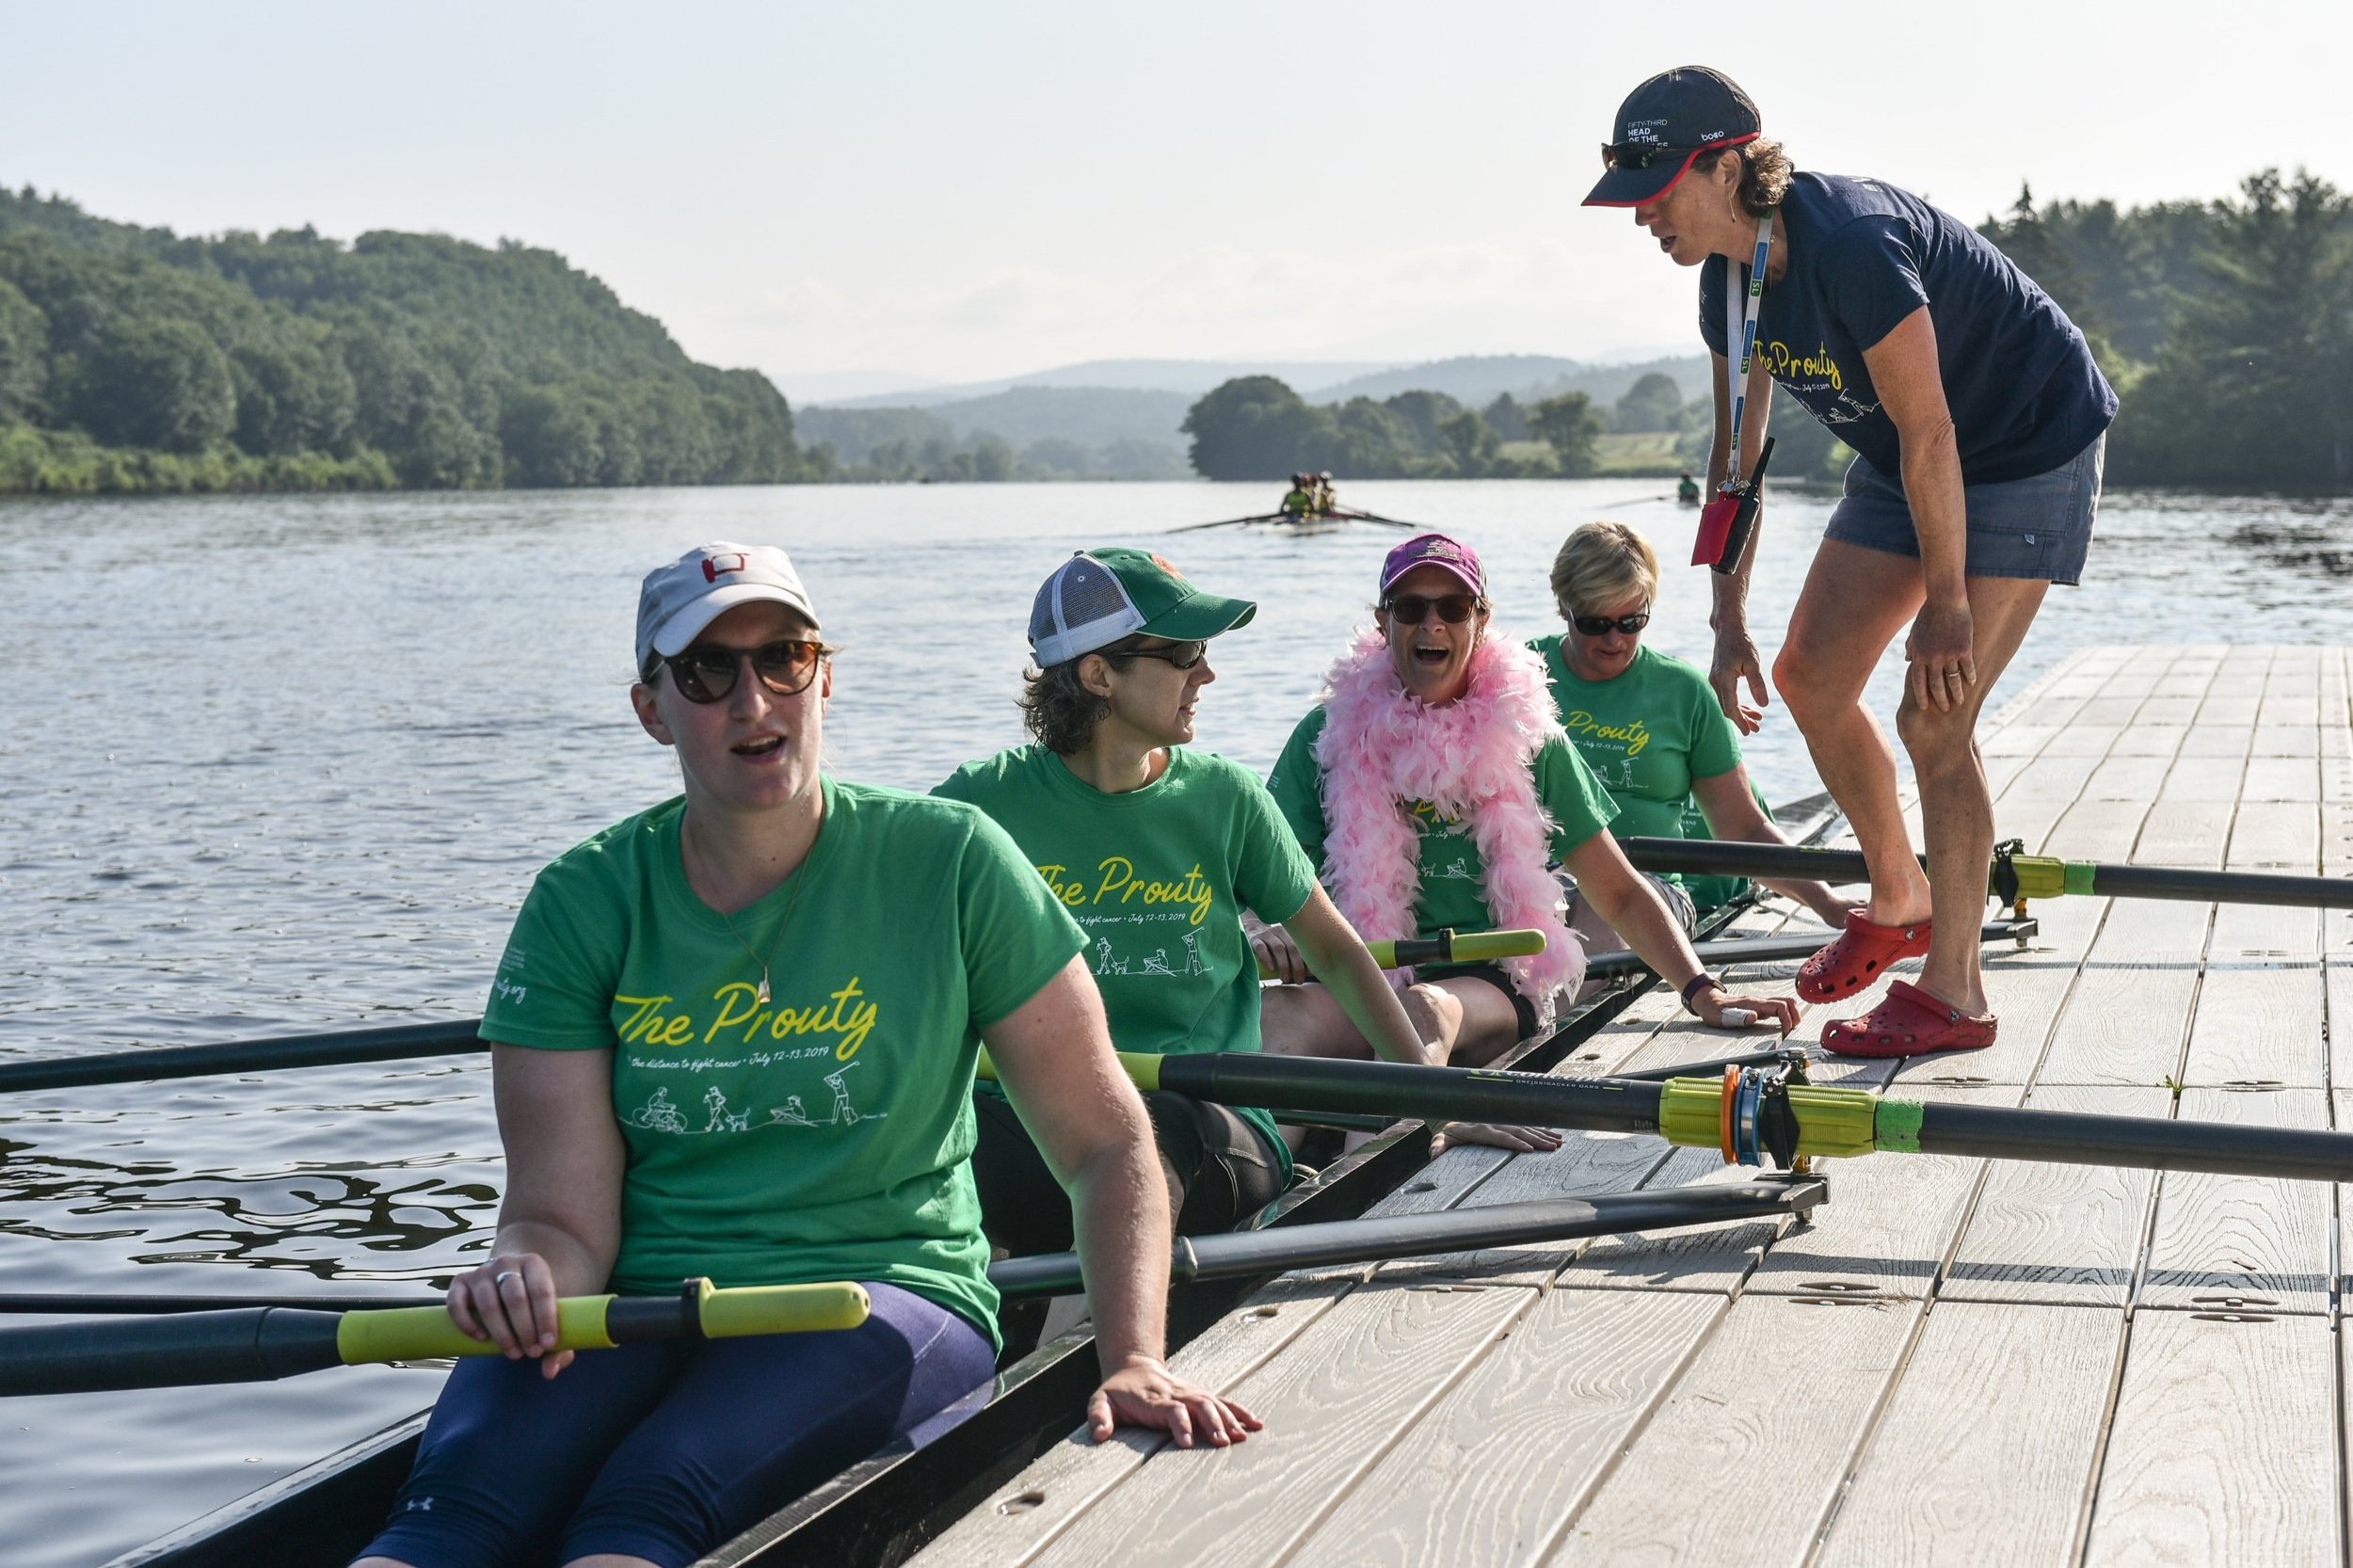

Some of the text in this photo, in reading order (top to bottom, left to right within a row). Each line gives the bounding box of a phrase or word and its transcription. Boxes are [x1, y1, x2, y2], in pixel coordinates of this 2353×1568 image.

[1627, 127, 1651, 137] HEAD
[1641, 135, 1659, 143] THE
[1752, 282, 1760, 294] SL
[1742, 360, 1749, 372] SL
[1753, 340, 1842, 391] The Prouty
[1567, 711, 1650, 756] Prouty
[1035, 856, 1212, 925] The Prouty
[1085, 915, 1102, 927] fight
[1128, 913, 1144, 925] July
[1168, 912, 1186, 921] 2019
[615, 976, 877, 1062] The Prouty
[646, 1058, 680, 1068] distance
[680, 1058, 690, 1068] to
[689, 1057, 715, 1073] fight
[749, 1051, 771, 1067] July
[804, 1046, 829, 1058] 2019
